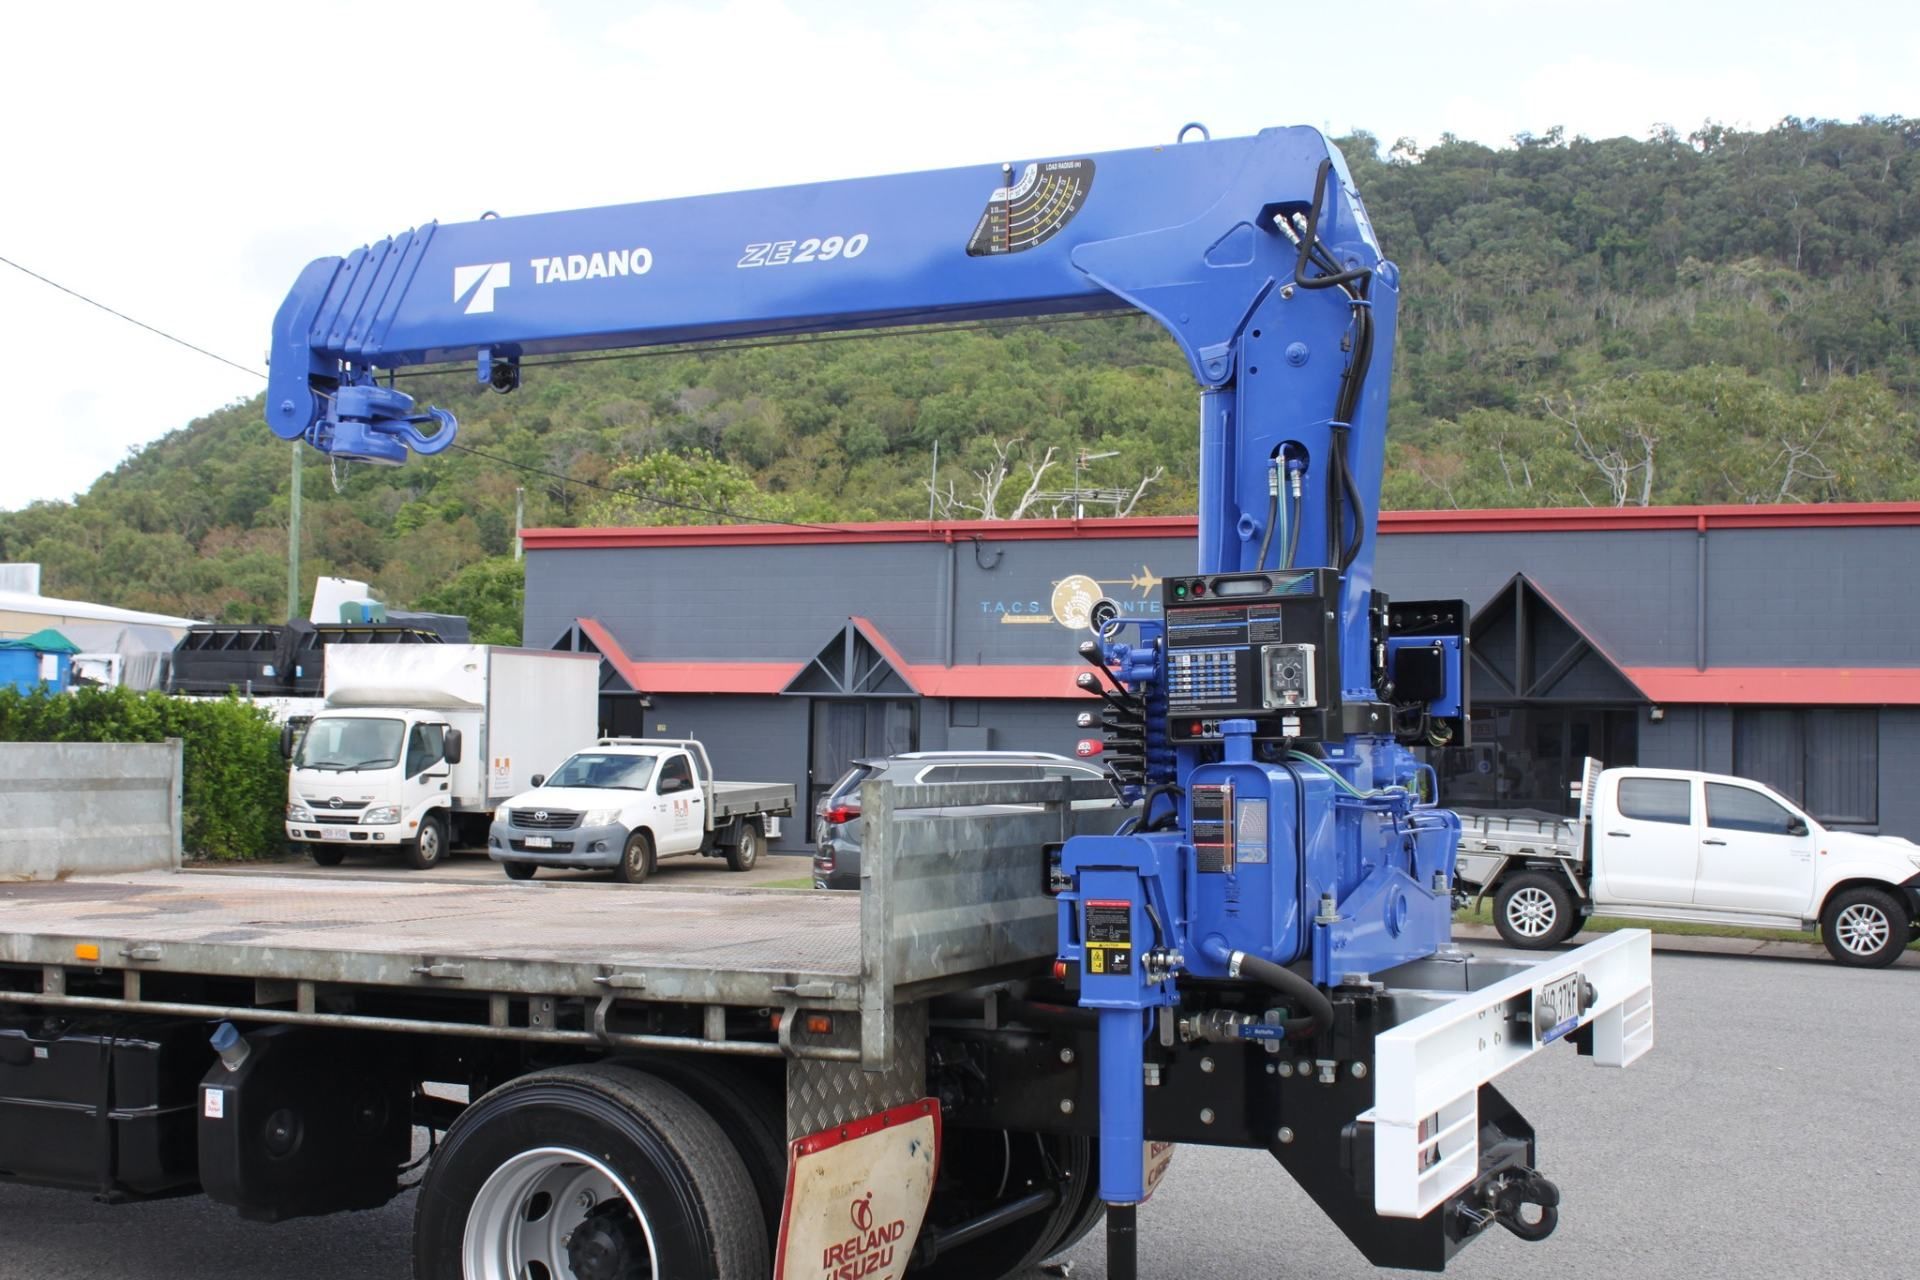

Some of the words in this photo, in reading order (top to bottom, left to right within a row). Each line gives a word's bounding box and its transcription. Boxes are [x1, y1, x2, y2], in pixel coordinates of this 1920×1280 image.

[1045, 163, 1057, 172] LOAD
[530, 247, 653, 284] TADANO
[736, 233, 869, 268] ZE290
[823, 1219, 905, 1270] IRELAND
[832, 1244, 893, 1280] ISUZU
